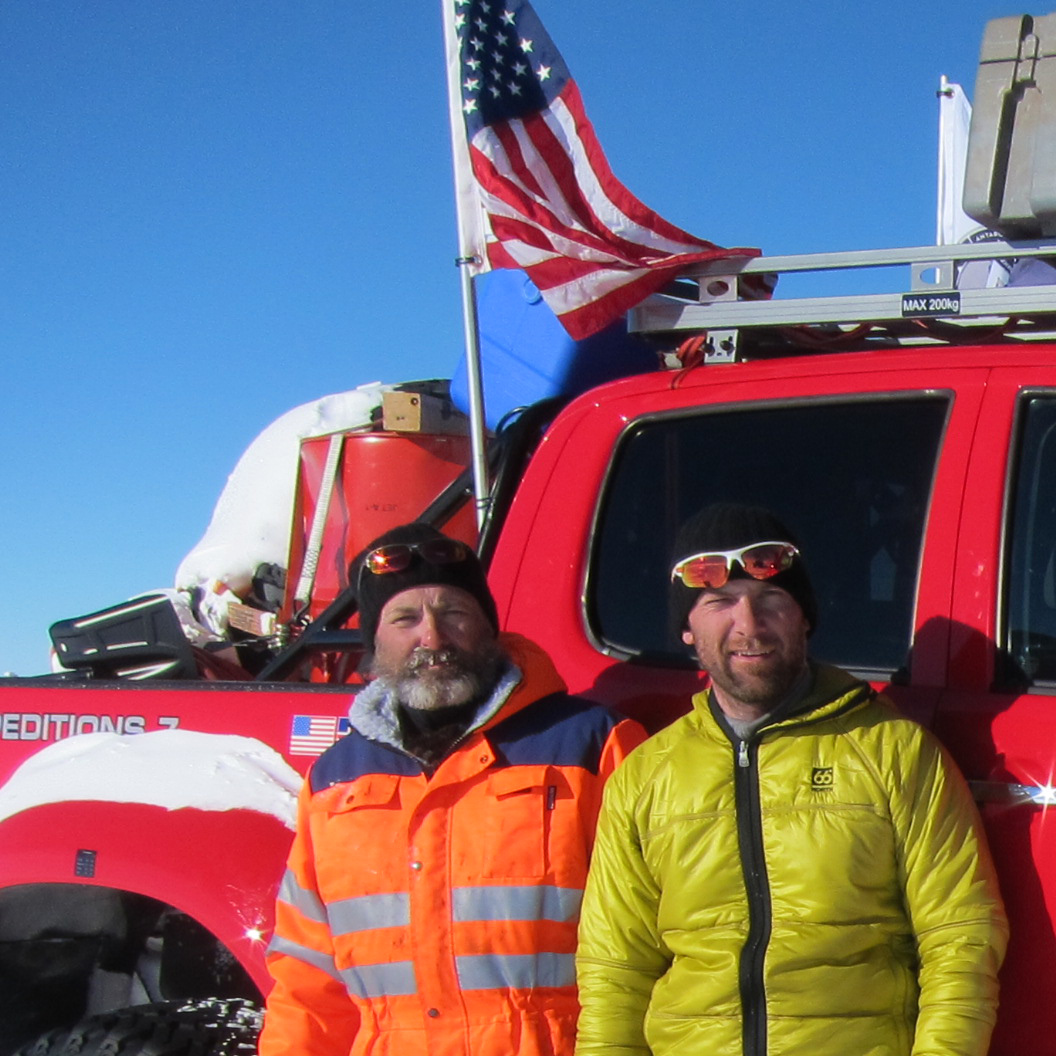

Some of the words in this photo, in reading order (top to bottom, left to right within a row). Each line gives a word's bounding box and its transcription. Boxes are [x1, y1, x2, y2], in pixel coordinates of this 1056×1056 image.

[903, 300, 927, 312] MAX
[929, 297, 959, 312] 200kg
[0, 713, 147, 741] EDITIONS
